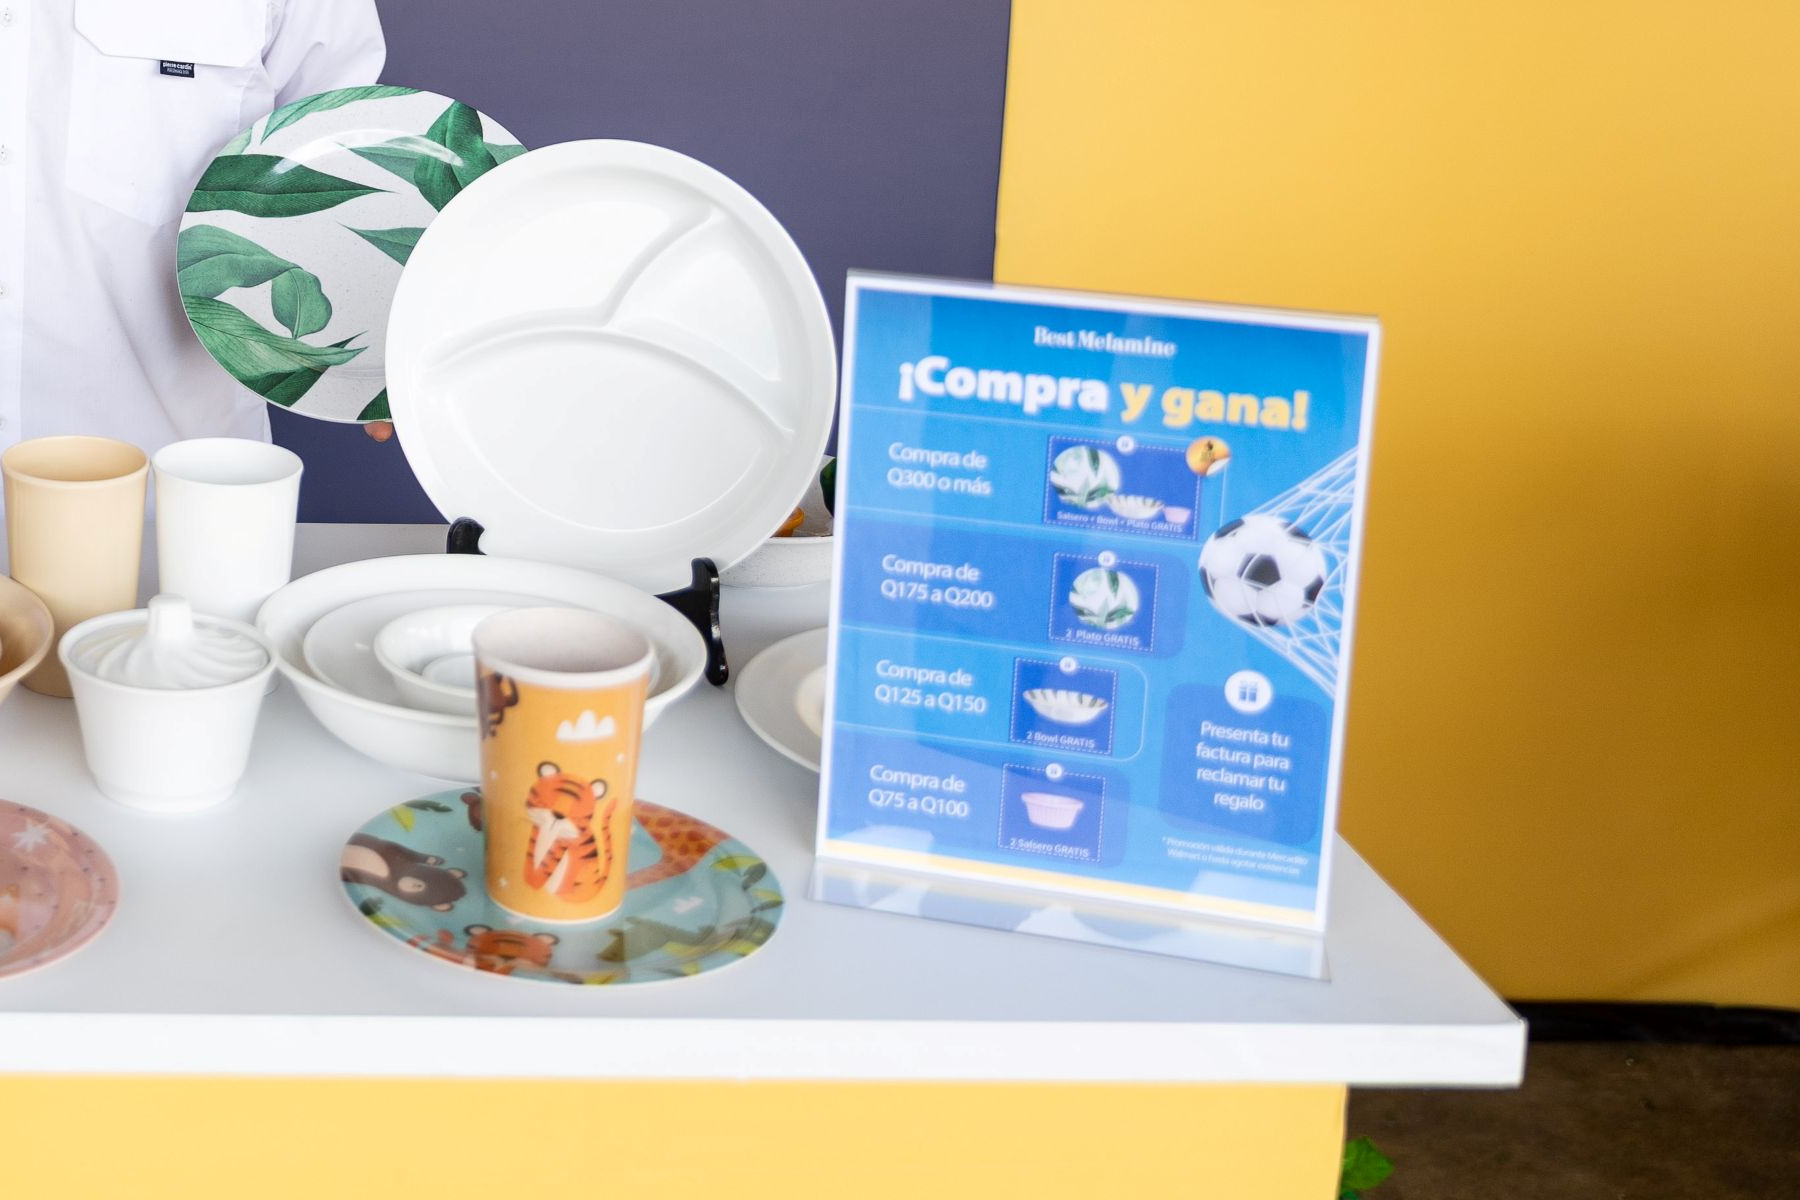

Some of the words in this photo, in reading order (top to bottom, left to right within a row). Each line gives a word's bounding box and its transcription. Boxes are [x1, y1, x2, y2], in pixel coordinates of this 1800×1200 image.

[1033, 326, 1075, 350] Best
[1077, 329, 1177, 358] Melamine
[898, 355, 1109, 415] ¡Compra
[1119, 381, 1153, 423] y
[1161, 388, 1310, 430] gana!
[888, 442, 960, 468] Compra
[962, 450, 988, 469] de
[887, 467, 936, 489] Q300
[937, 477, 951, 491] o
[953, 475, 992, 496] más
[1127, 516, 1150, 531] Plato
[1151, 521, 1184, 534] GRATIS
[882, 554, 953, 579] Compra
[955, 562, 980, 582] de
[881, 578, 928, 600] Q175
[930, 589, 943, 604] a
[944, 586, 994, 609] Q200
[1076, 629, 1102, 643] Plato
[1103, 631, 1140, 648] GRATIS
[876, 659, 946, 685] Compra
[949, 668, 973, 686] de
[874, 683, 921, 705] Q125
[924, 694, 935, 708] a
[937, 691, 987, 714] Q150
[1034, 731, 1059, 745] Bowl
[1060, 735, 1095, 749] GRATIS
[1200, 720, 1269, 746] Presenta
[1271, 732, 1290, 748] tu
[1196, 742, 1250, 765] factura
[1253, 754, 1290, 771] para
[870, 764, 939, 790] Compra
[942, 774, 966, 792] de
[1196, 766, 1265, 789] reclamar
[1268, 775, 1286, 792] tu
[868, 788, 905, 809] Q75
[907, 797, 918, 811] a
[920, 795, 969, 818] Q100
[1213, 791, 1265, 812] regalo
[1018, 837, 1053, 853] Salsero
[1054, 843, 1090, 859] GRATIS
